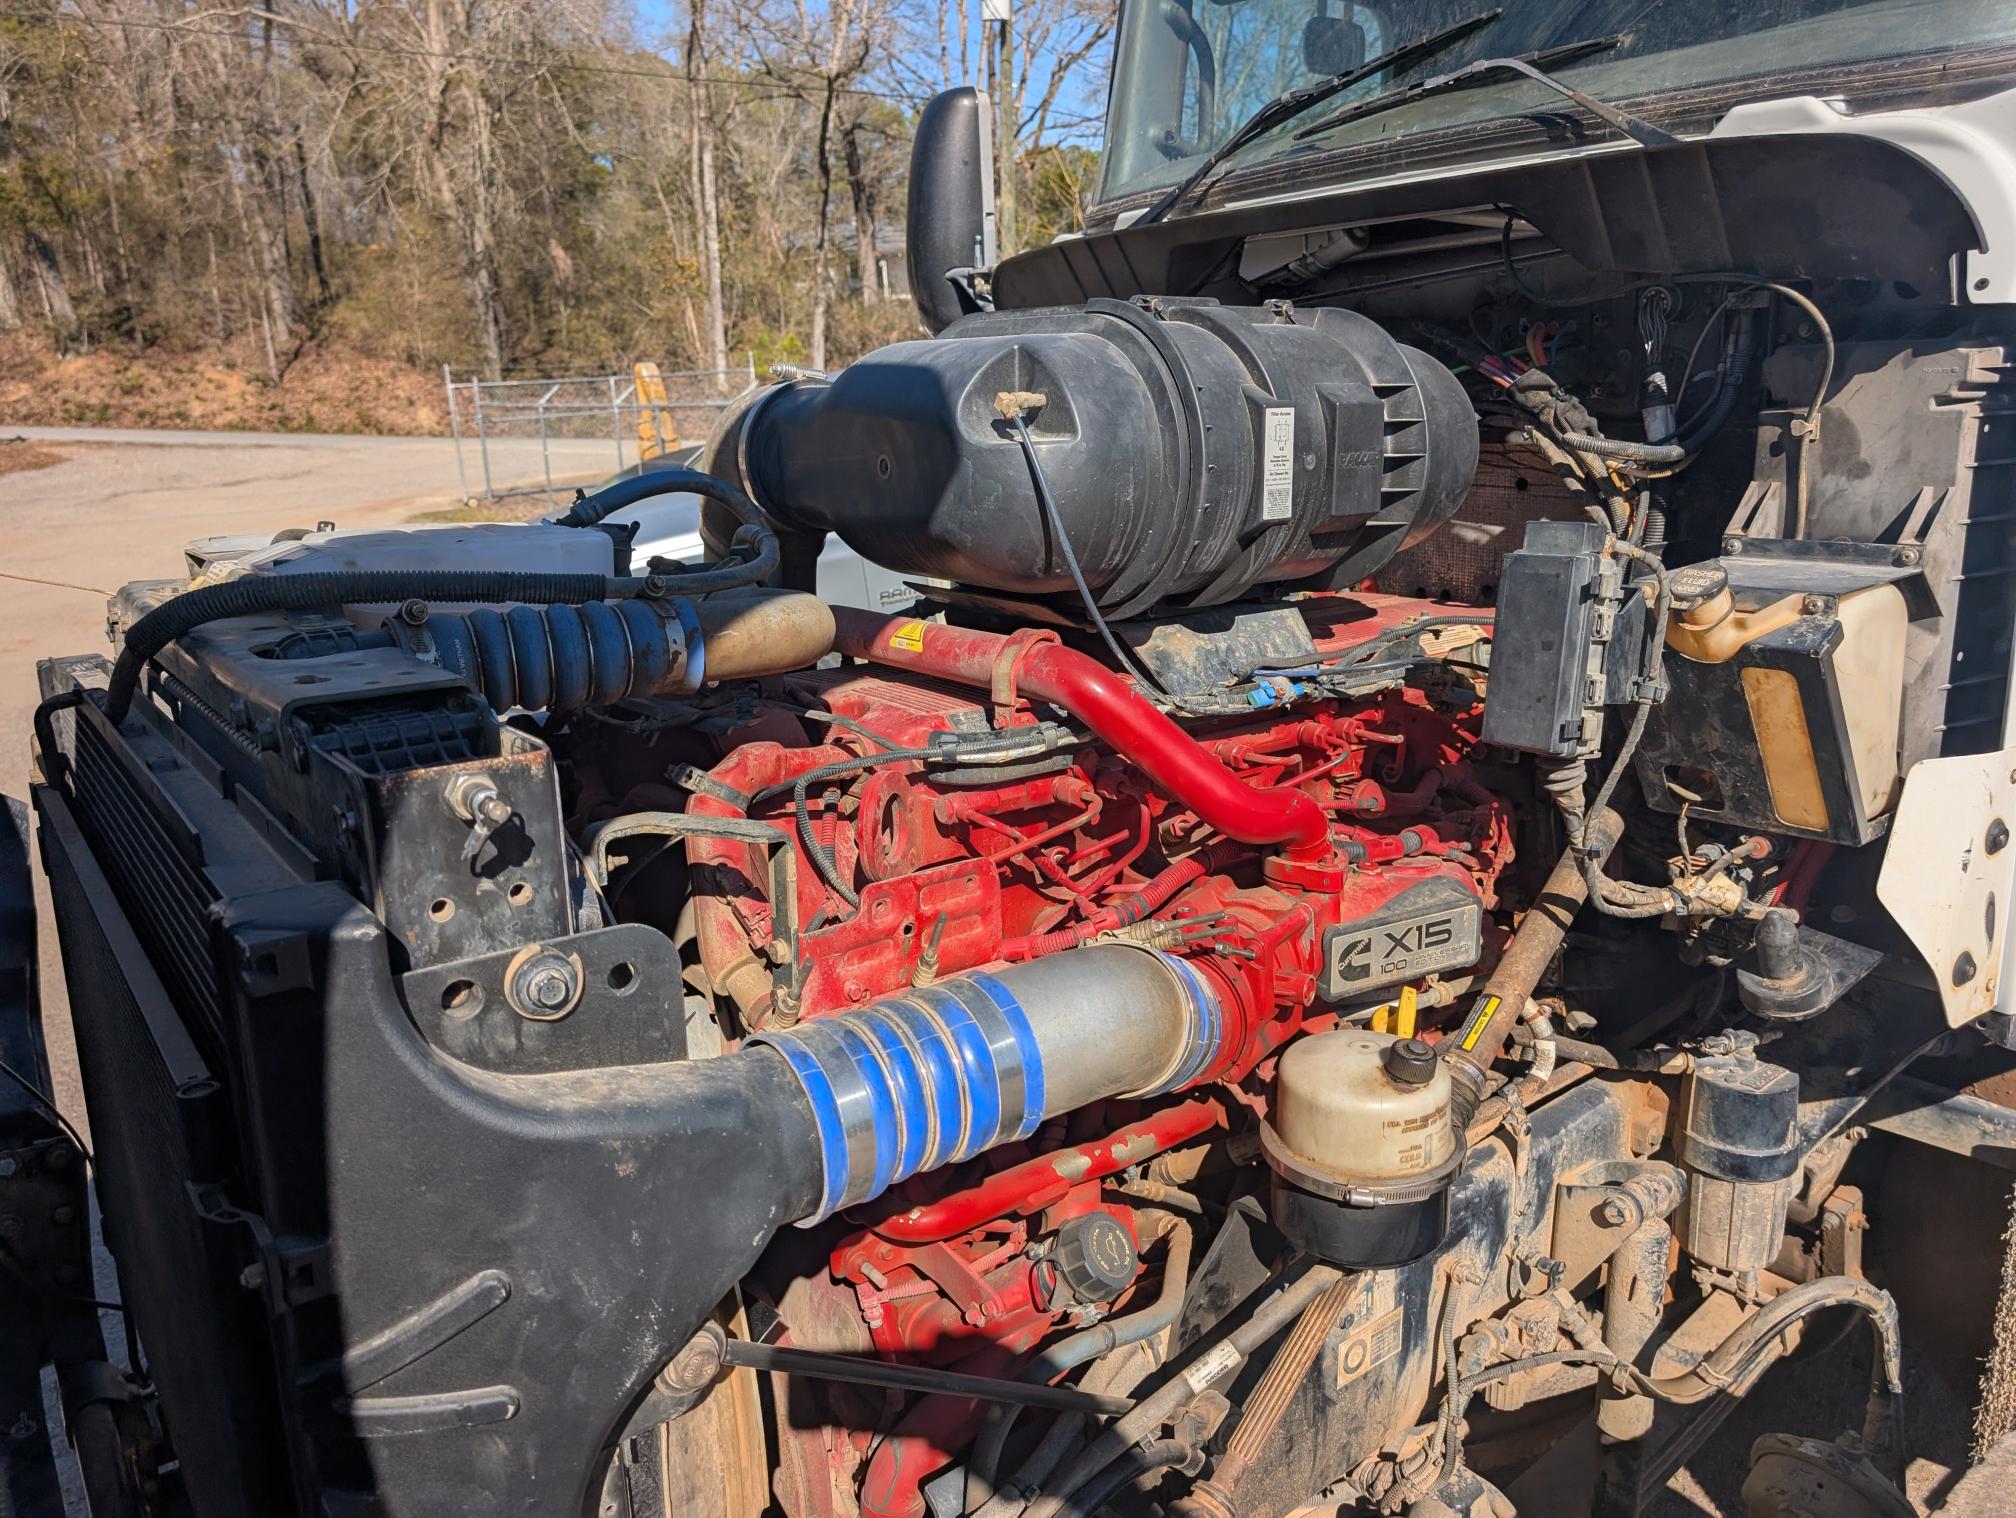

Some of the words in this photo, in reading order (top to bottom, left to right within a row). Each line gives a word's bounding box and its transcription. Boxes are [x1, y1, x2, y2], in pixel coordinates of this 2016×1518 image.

[1682, 577, 1710, 586] FLUID
[1683, 568, 1721, 580] WASHER
[1382, 918, 1453, 960] X15
[1338, 937, 1369, 970] Cummins
[1380, 959, 1408, 975] 100
